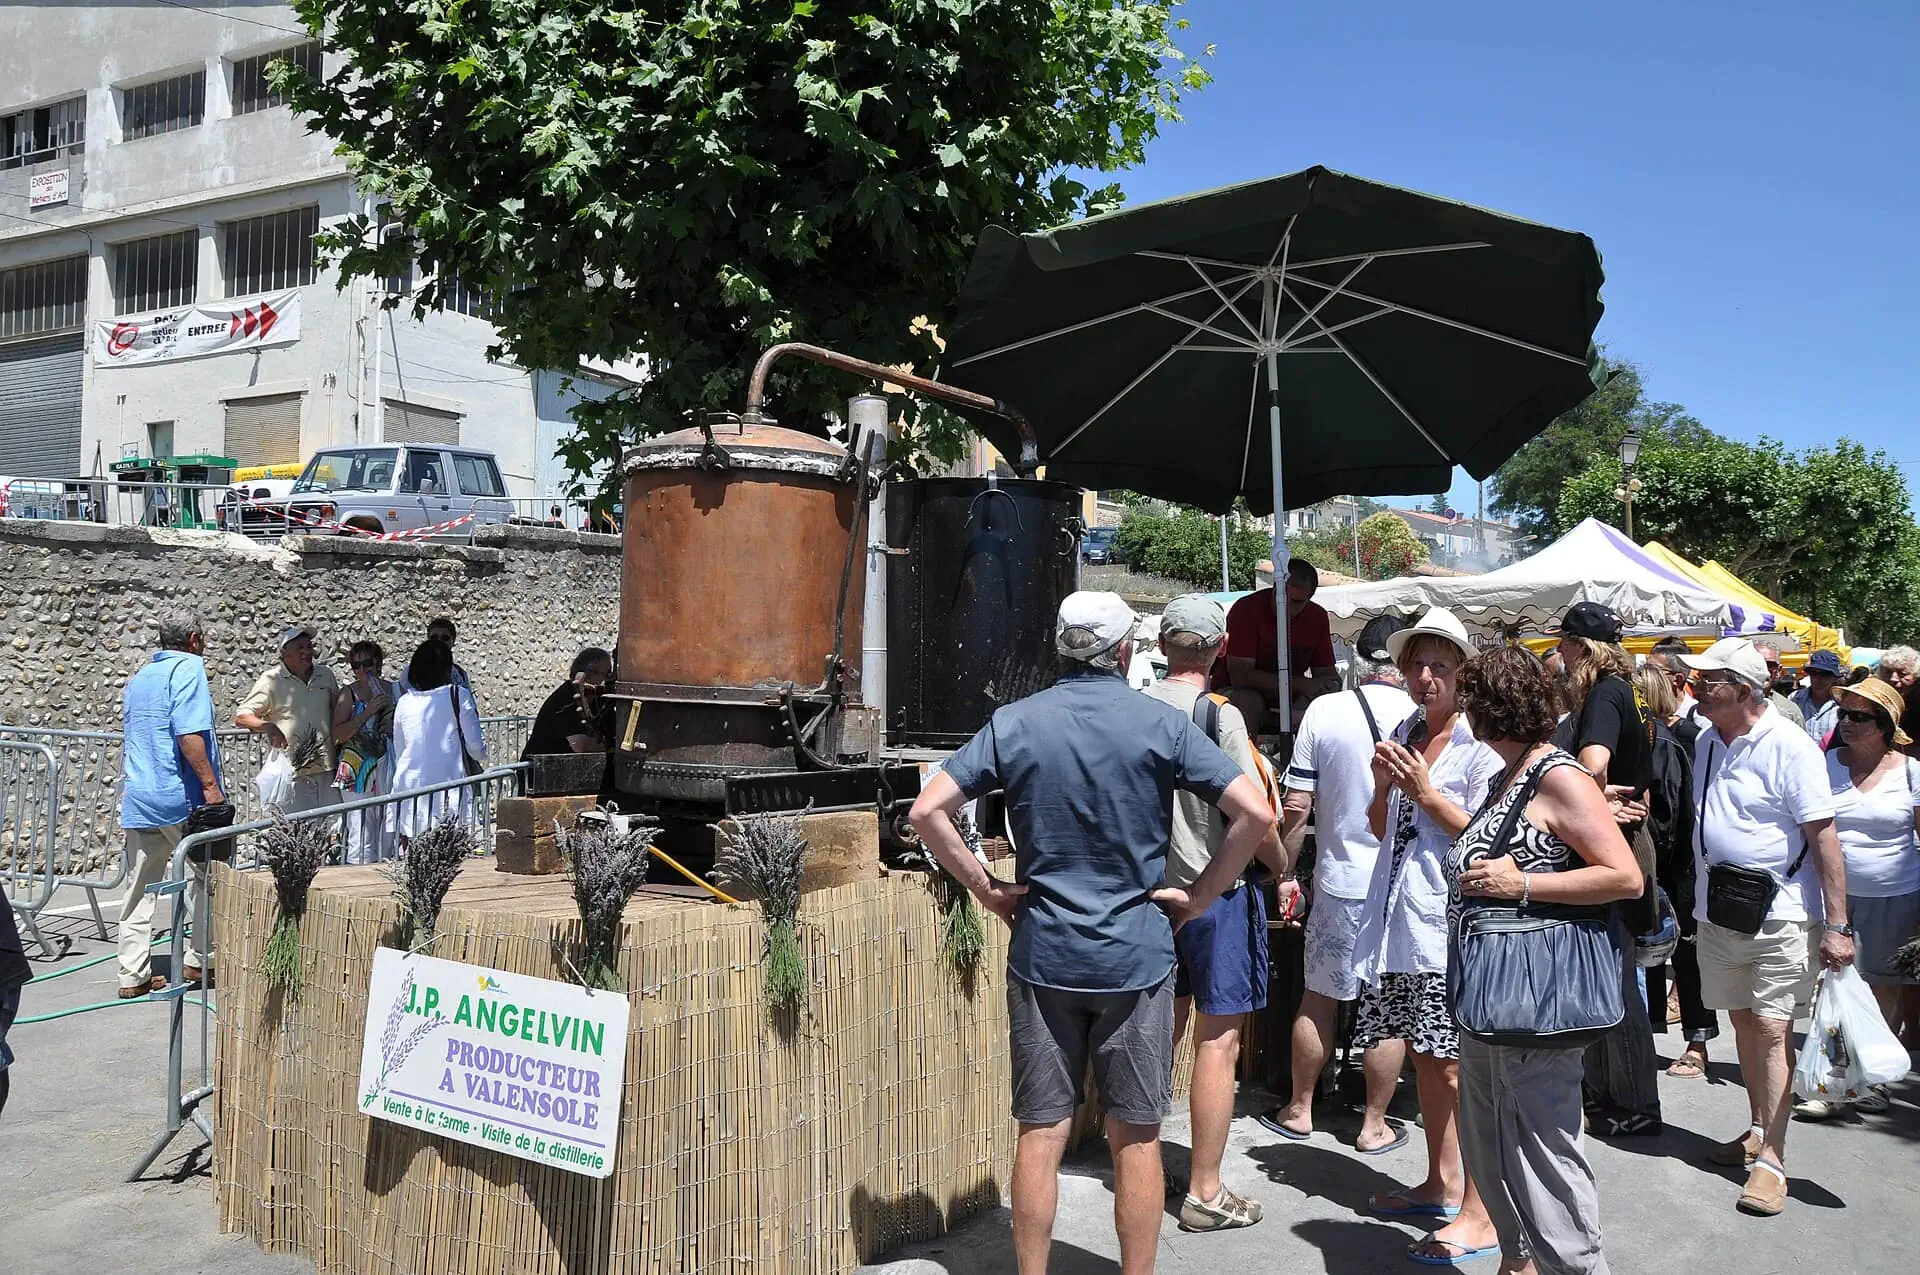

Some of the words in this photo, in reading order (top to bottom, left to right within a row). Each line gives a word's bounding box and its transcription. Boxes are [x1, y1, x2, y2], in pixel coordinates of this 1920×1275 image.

[32, 171, 68, 188] EXPOSITION
[404, 984, 441, 1019] J.P.
[454, 995, 605, 1056] ANGELVIN
[438, 1067, 455, 1093] A
[464, 1073, 599, 1130] VALENSOLE
[445, 1038, 600, 1097] PRODUCTEUR
[383, 1096, 412, 1118] Vente
[415, 1105, 422, 1121] à
[424, 1108, 435, 1124] la
[481, 1122, 512, 1145] Visite
[515, 1133, 531, 1150] de
[534, 1137, 546, 1154] la
[549, 1142, 604, 1169] distillerie
